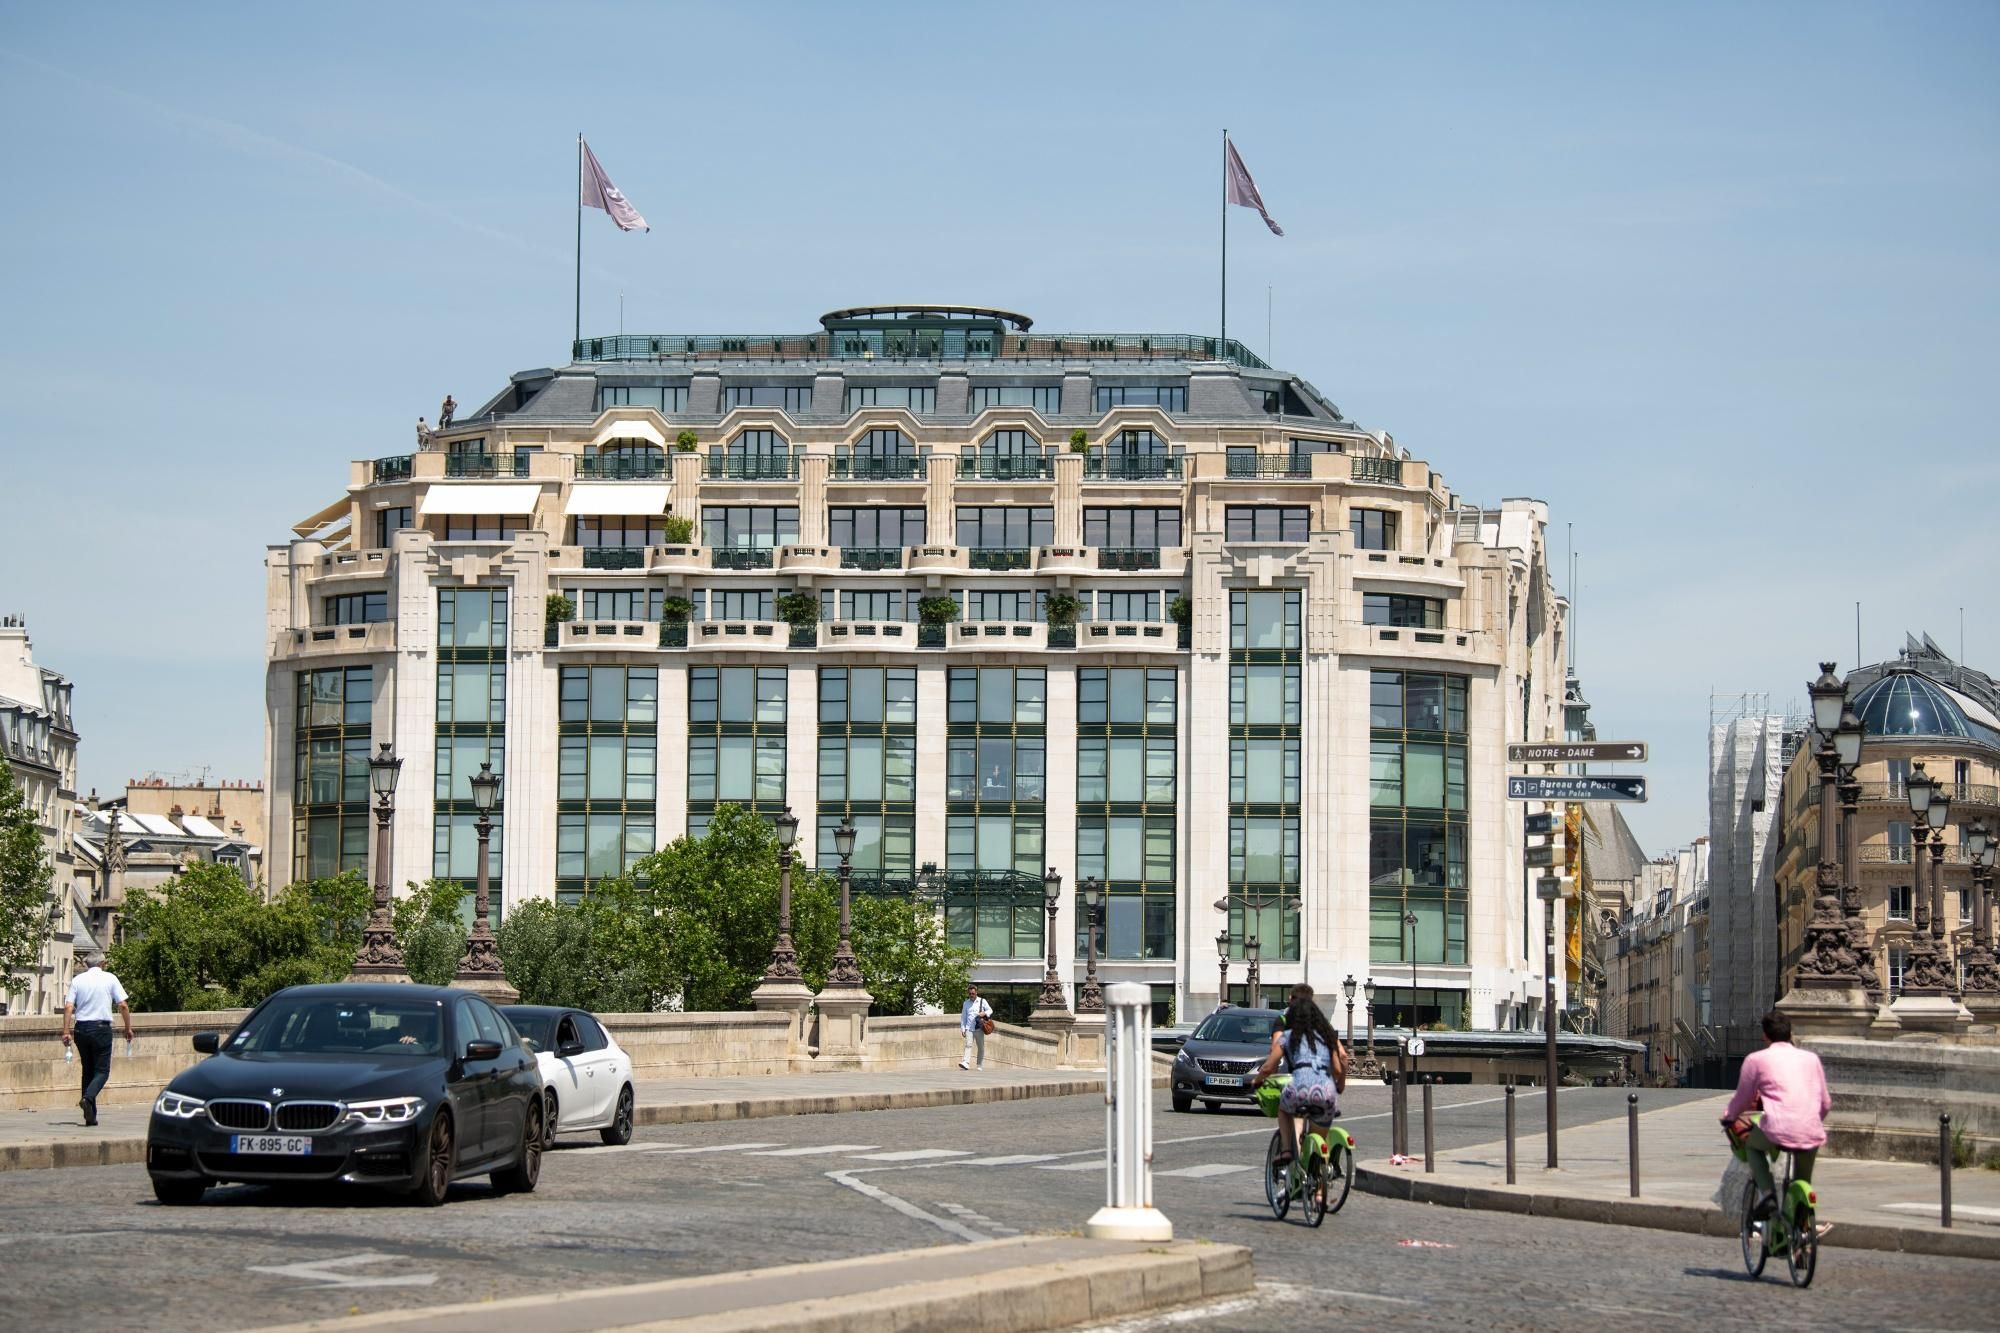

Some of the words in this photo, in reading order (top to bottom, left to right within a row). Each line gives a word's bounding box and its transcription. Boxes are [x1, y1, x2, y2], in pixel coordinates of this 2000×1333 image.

[1528, 748, 1559, 758] NOTRE
[1567, 748, 1595, 757] DAME
[1540, 779, 1572, 789] Bureau
[1576, 780, 1587, 789] de
[1591, 780, 1617, 789] Poste
[1556, 789, 1566, 797] du
[1568, 789, 1591, 798] Palais
